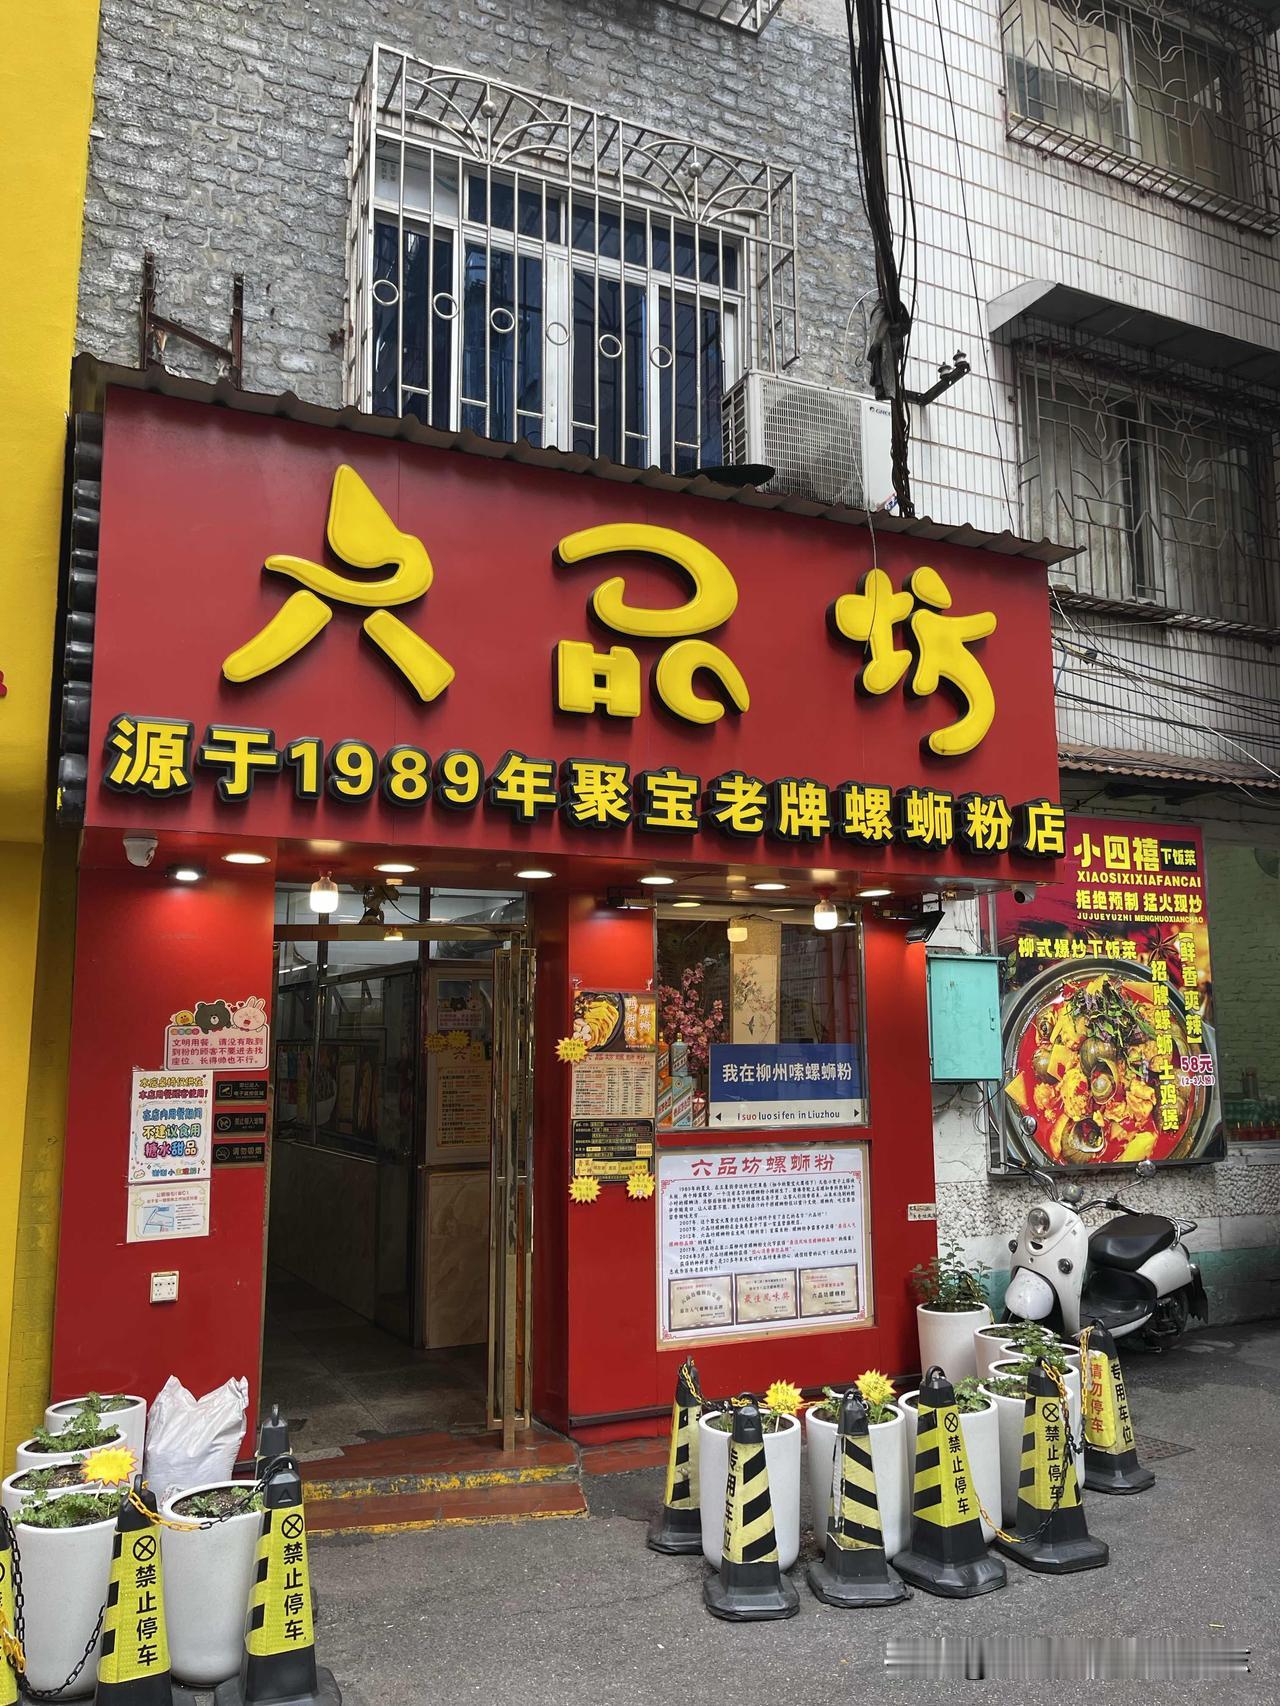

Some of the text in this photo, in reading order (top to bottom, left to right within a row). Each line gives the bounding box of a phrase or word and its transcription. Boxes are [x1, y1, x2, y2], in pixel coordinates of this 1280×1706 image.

[222, 464, 997, 756] 六品坊
[109, 718, 1065, 855] 源于1989年聚宝老牌螺蛳粉店
[1160, 847, 1196, 866] 下饭菜
[1077, 871, 1201, 888] XIAOSIXIXIAFANCAI
[1076, 890, 1202, 913] 拒绝预制 猛火现炒
[1077, 913, 1204, 924] JUJUEYUZHI MENGHUOXIANCHAO
[1018, 937, 1137, 960] 柳式爆炒下饭菜
[1151, 960, 1179, 1131] 招牌螺蛳土鸡煲
[722, 1063, 852, 1082] 我在柳州嗦螺蛳粉
[1180, 1053, 1213, 1073] 58元
[798, 1110, 806, 1119] in
[808, 1110, 840, 1119] Liuzhou
[142, 1122, 202, 1139] 不建议食用
[144, 1140, 198, 1157] 糖水甜品
[691, 1153, 835, 1176] 六品坊螺蛳粉
[1090, 1363, 1104, 1433] 请勿停车
[1110, 1363, 1132, 1445] 专用车位
[1045, 1425, 1064, 1500] 禁止停车
[948, 1435, 970, 1515] 禁止停车
[283, 1542, 304, 1641] 禁止停车
[135, 1563, 158, 1667] 禁止停车
